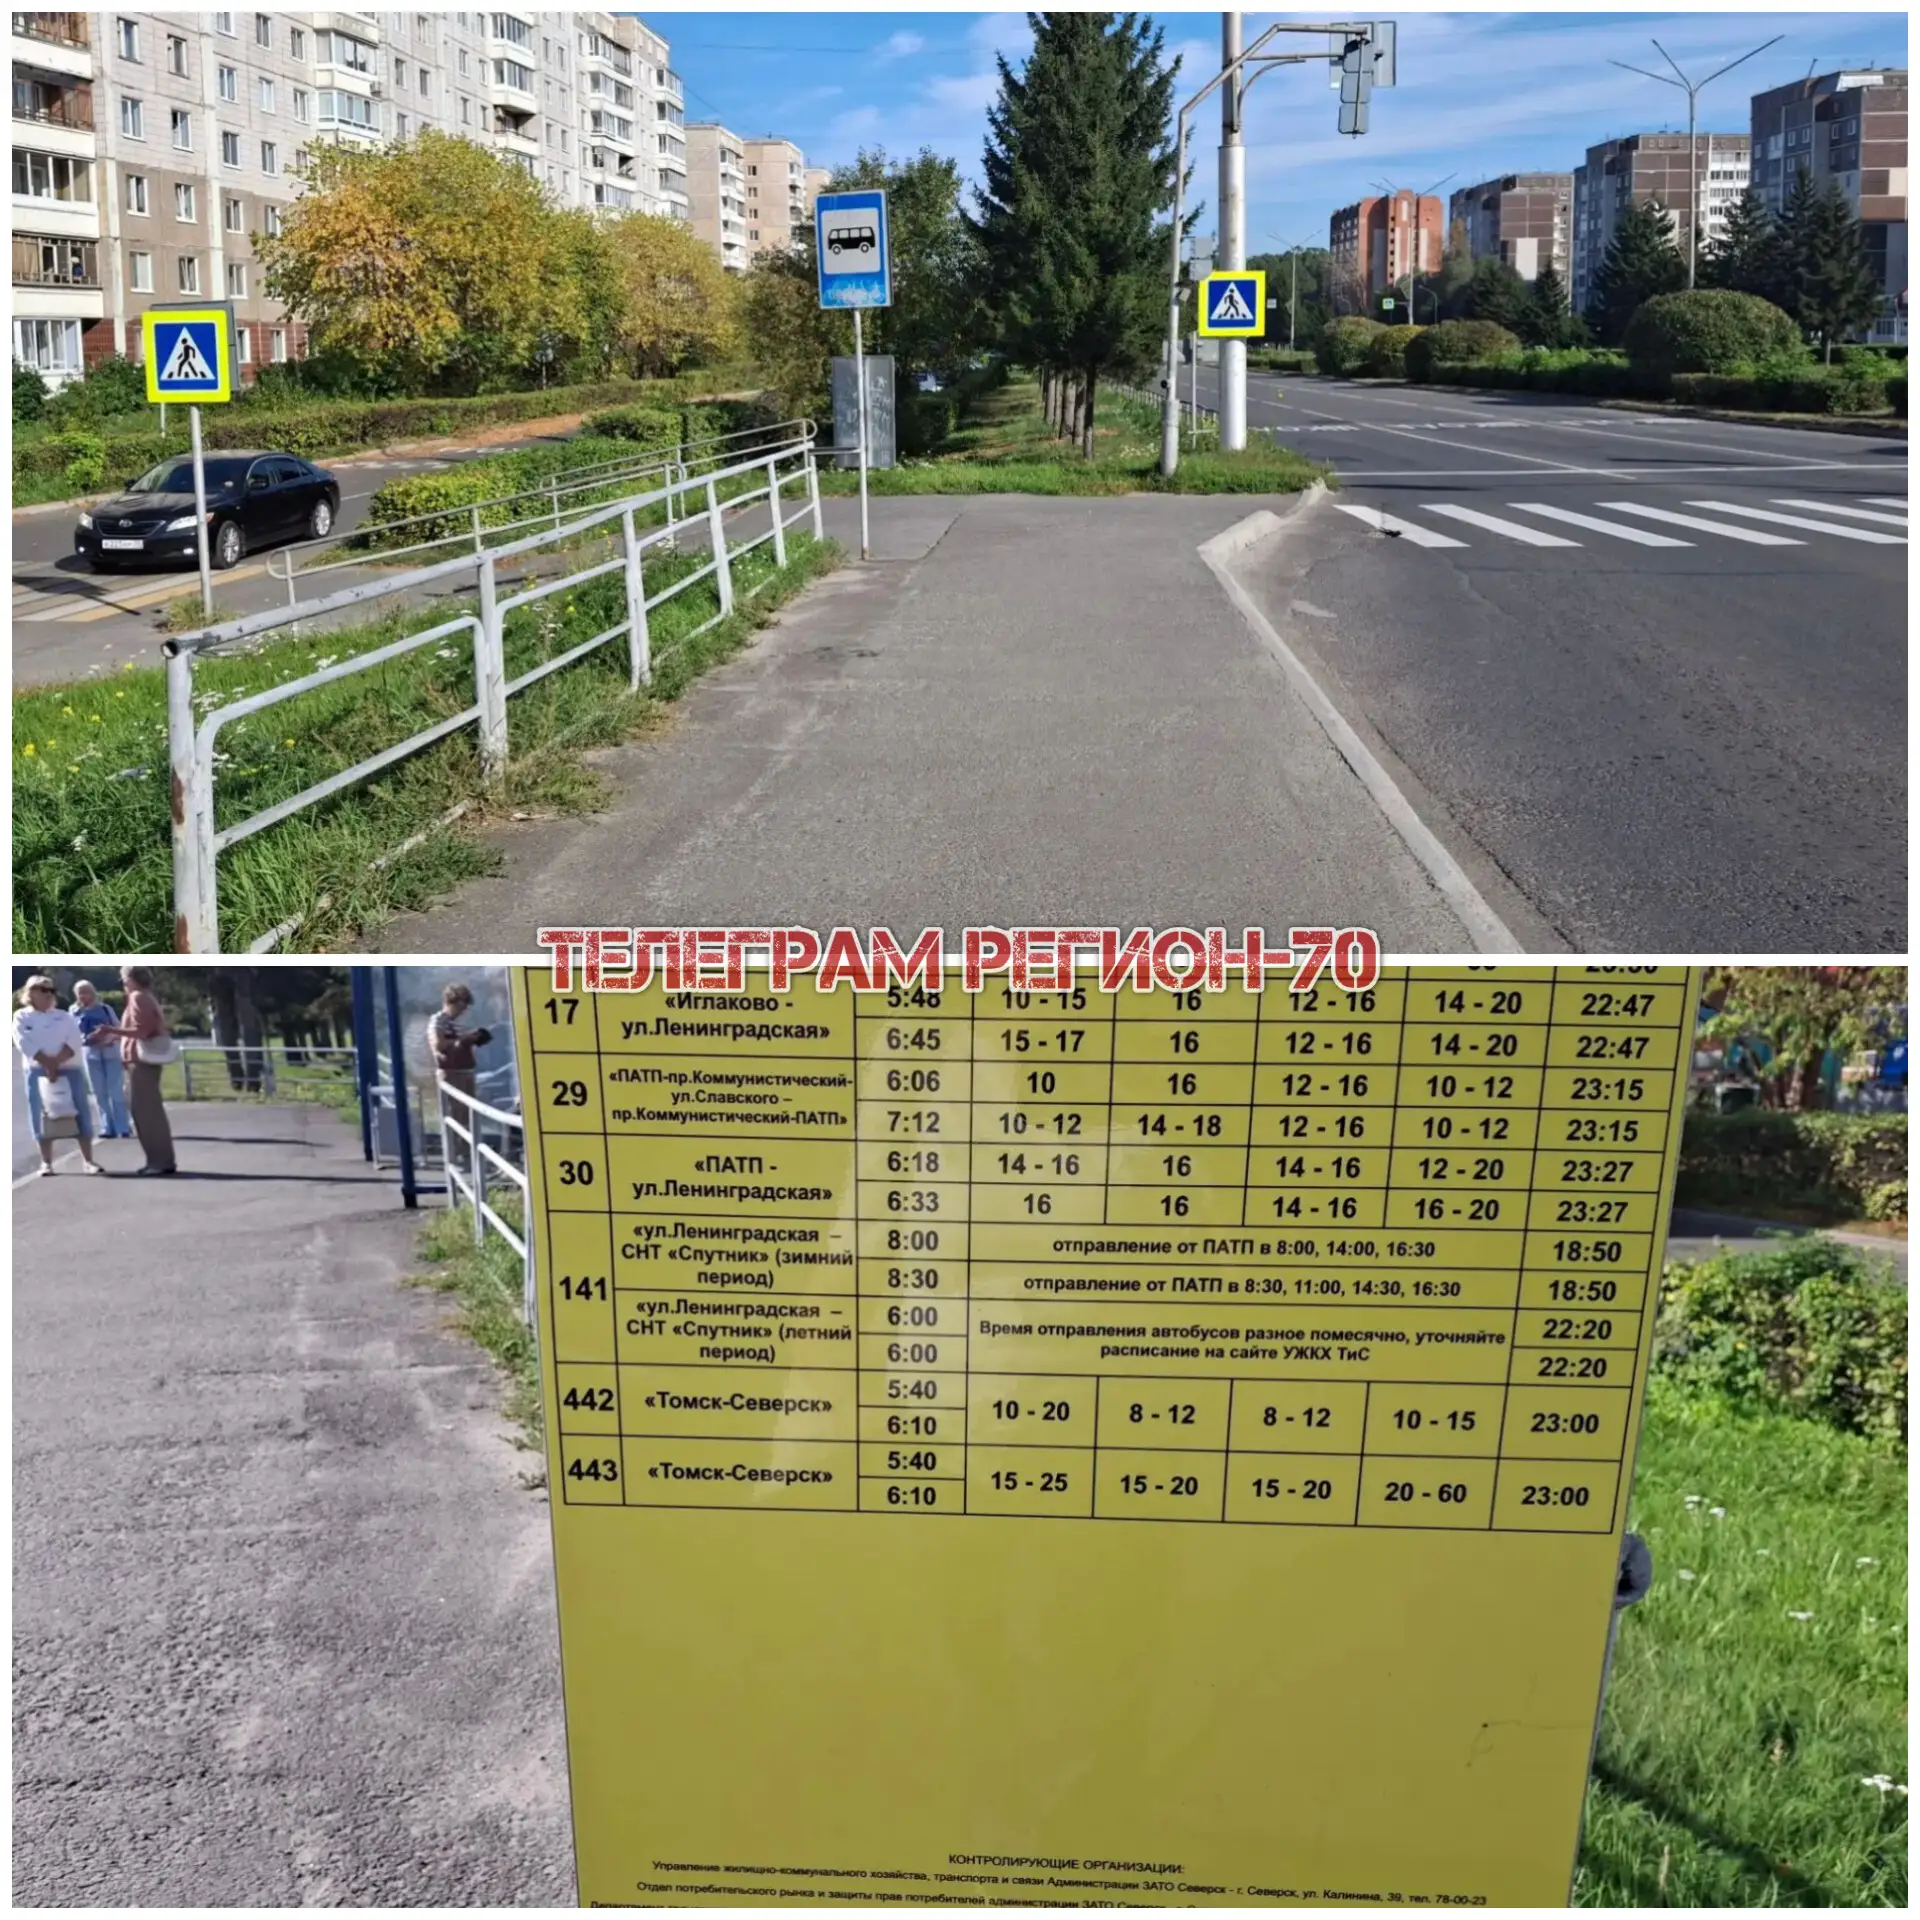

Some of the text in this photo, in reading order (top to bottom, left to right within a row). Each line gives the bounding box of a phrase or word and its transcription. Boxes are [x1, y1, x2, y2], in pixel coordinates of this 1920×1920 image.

[544, 998, 579, 1025] 17
[665, 992, 779, 1011] «Иглаково
[1289, 990, 1375, 1012] 12 16
[1435, 990, 1522, 1014] 14 20
[1581, 993, 1655, 1017] 22:47
[621, 1017, 830, 1042] ул.Ленинградская»
[887, 1028, 940, 1051] 6:45
[1001, 1029, 1085, 1052] 15 17
[1170, 1030, 1199, 1054] 16
[1285, 1031, 1372, 1055] 12 16
[1431, 1033, 1518, 1057] 14 20
[1575, 1035, 1650, 1059] 22:47
[609, 1068, 854, 1089] «ПАТП-пр.Коммунистический-
[887, 1069, 940, 1092] 6:06
[1027, 1071, 1055, 1094] 10
[1168, 1073, 1196, 1095] 16
[1283, 1074, 1368, 1097] 12 16
[1427, 1075, 1513, 1098] 10 12
[1570, 1077, 1644, 1101] 23:15
[552, 1080, 588, 1107] 29
[671, 1089, 779, 1105] ул.Славского
[612, 1107, 847, 1125] пр.Коммунистический-ПАТП»
[887, 1111, 939, 1133] 7:12
[999, 1112, 1081, 1135] 10 12
[1138, 1114, 1221, 1137] 14 18
[1279, 1115, 1364, 1138] 12 16
[1423, 1117, 1509, 1140] 10 12
[1566, 1119, 1638, 1142] 23:15
[559, 1160, 594, 1186] 30
[694, 1156, 763, 1174] «ПАТП
[887, 1151, 939, 1173] 6:18
[998, 1153, 1079, 1175] 14 16
[1163, 1155, 1191, 1177] 16
[1276, 1156, 1360, 1179] 14 16
[1419, 1158, 1504, 1180] 12 20
[1561, 1160, 1634, 1182] 23:27
[632, 1179, 832, 1203] ул.Ленинградская»
[887, 1190, 939, 1212] 6:33
[1024, 1193, 1051, 1214] 16
[1161, 1195, 1189, 1216] 16
[1273, 1196, 1357, 1219] 14 16
[1415, 1198, 1499, 1221] 16 20
[1556, 1200, 1628, 1223] 23:27
[633, 1222, 819, 1244] «ул.Ленинградская
[888, 1229, 939, 1251] 8:00
[621, 1243, 853, 1268] СНТ «Спутник» (зимний
[1053, 1239, 1435, 1259] отправление от ПАТП в 8:00, 14:00, 16:30
[1553, 1240, 1622, 1263] 18:50
[559, 1276, 607, 1301] 141
[697, 1270, 774, 1289] период)
[888, 1268, 938, 1289] 8:30
[1024, 1277, 1461, 1298] отправление от ПАТП в 8:30, 11:00, 14:30, 16:30
[1549, 1280, 1616, 1302] 18:50
[636, 1298, 820, 1320] «ул.Ленинградская
[888, 1306, 938, 1327] 6:00
[627, 1319, 851, 1342] СНТ «Спутник» (летний
[980, 1320, 1505, 1346] Время отправления автобусов разное помесячно, уточняйте
[1542, 1318, 1612, 1340] 22:20
[700, 1345, 775, 1364] период)
[888, 1343, 937, 1363] 6:00
[1101, 1345, 1370, 1361] расписание на сайте УЖКХ ТиС
[1537, 1357, 1607, 1378] 22:20
[563, 1387, 615, 1411] 442
[888, 1380, 937, 1400] 5:40
[645, 1391, 832, 1415] «Томск-Северск»
[993, 1400, 1070, 1421] 10 20
[1129, 1403, 1195, 1424] 8 12
[887, 1415, 937, 1435] 6:10
[1263, 1406, 1330, 1427] 8 12
[1394, 1409, 1476, 1431] 10 15
[1530, 1413, 1599, 1434] 23:00
[567, 1458, 618, 1482] 443
[888, 1451, 936, 1471] 5:40
[648, 1462, 833, 1486] «Томск-Северск»
[991, 1471, 1068, 1492] 15 25
[1120, 1474, 1198, 1496] 15 20
[887, 1486, 936, 1505] 6:10
[1252, 1478, 1331, 1499] 15 20
[1384, 1482, 1467, 1503] 20 60
[1521, 1486, 1589, 1506] 23:00
[949, 1854, 1185, 1875] КОНТРОЛИРУЮЩИЕ ОРГАНИЗАЦИИ:
[652, 1860, 720, 1873] Управление
[934, 1873, 999, 1886] транспорта
[1012, 1876, 1043, 1886] связи
[1047, 1877, 1139, 1891] Администрации
[1143, 1880, 1174, 1892] ЗАТО
[1436, 1894, 1487, 1906] 78-00-23
